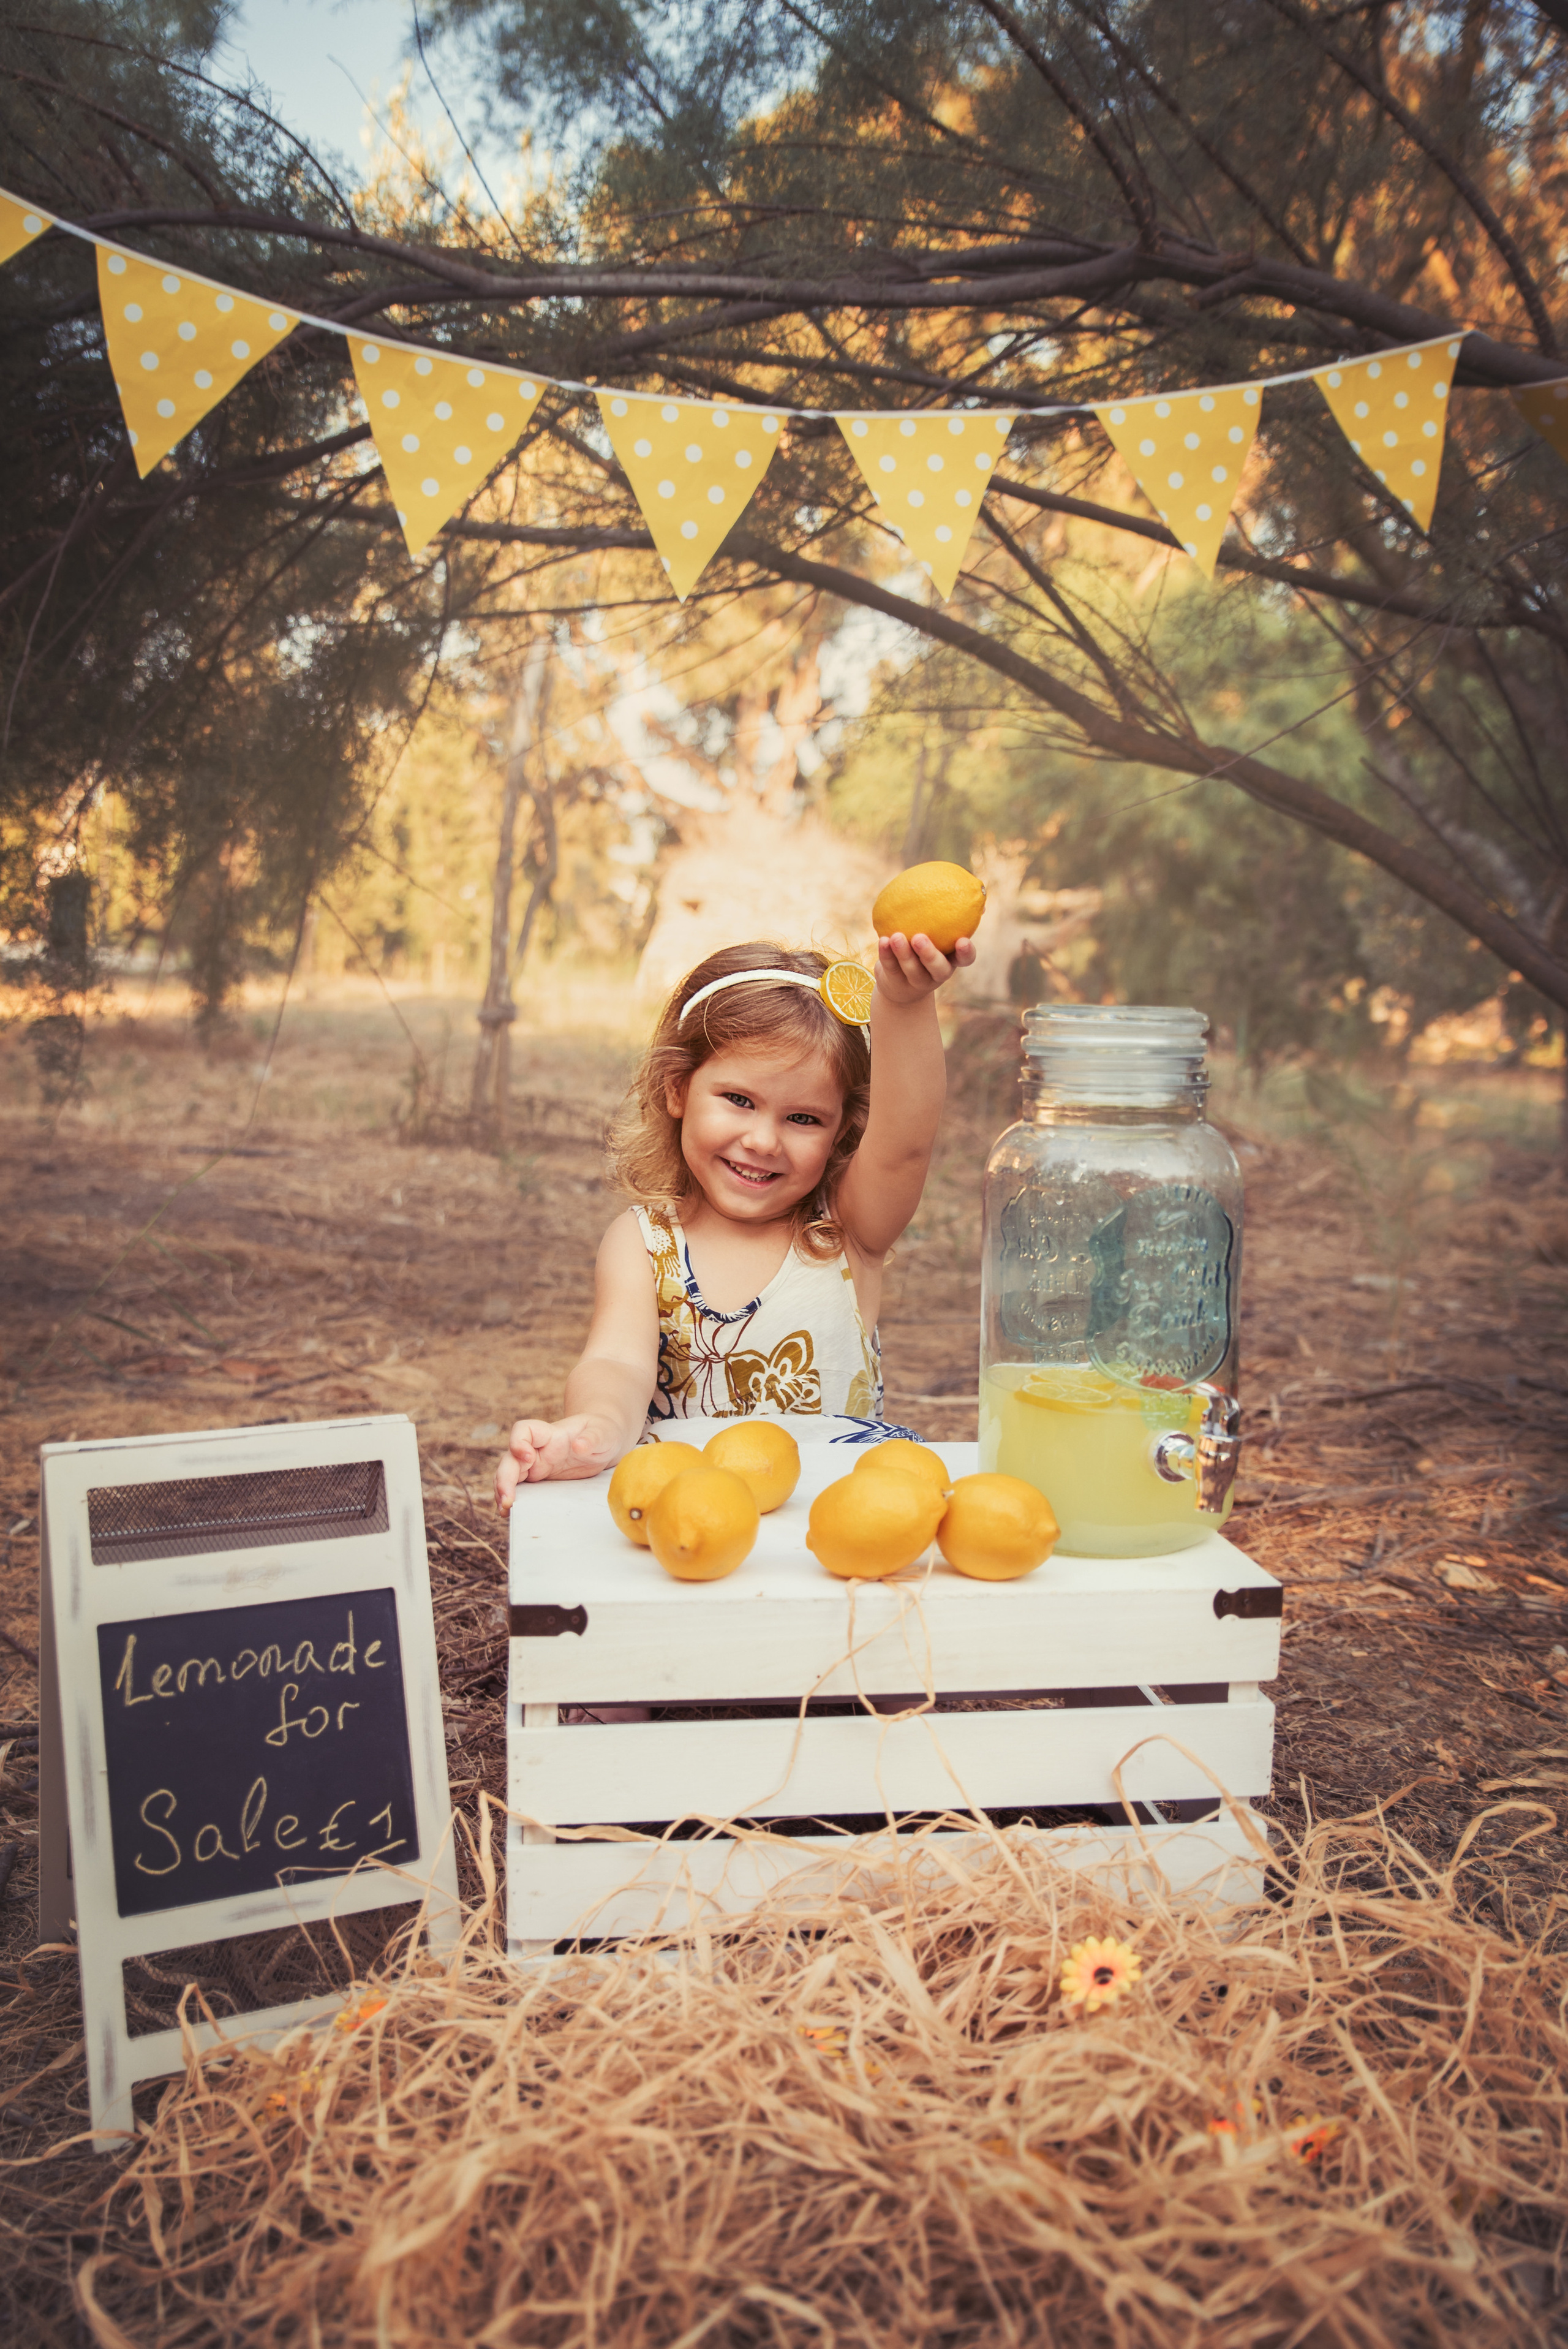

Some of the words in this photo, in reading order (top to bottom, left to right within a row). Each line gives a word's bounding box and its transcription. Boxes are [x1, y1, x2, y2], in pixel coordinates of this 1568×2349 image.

[115, 1610, 386, 1706] Lemonade
[265, 1682, 360, 1746] for
[134, 1776, 307, 1875] Sale
